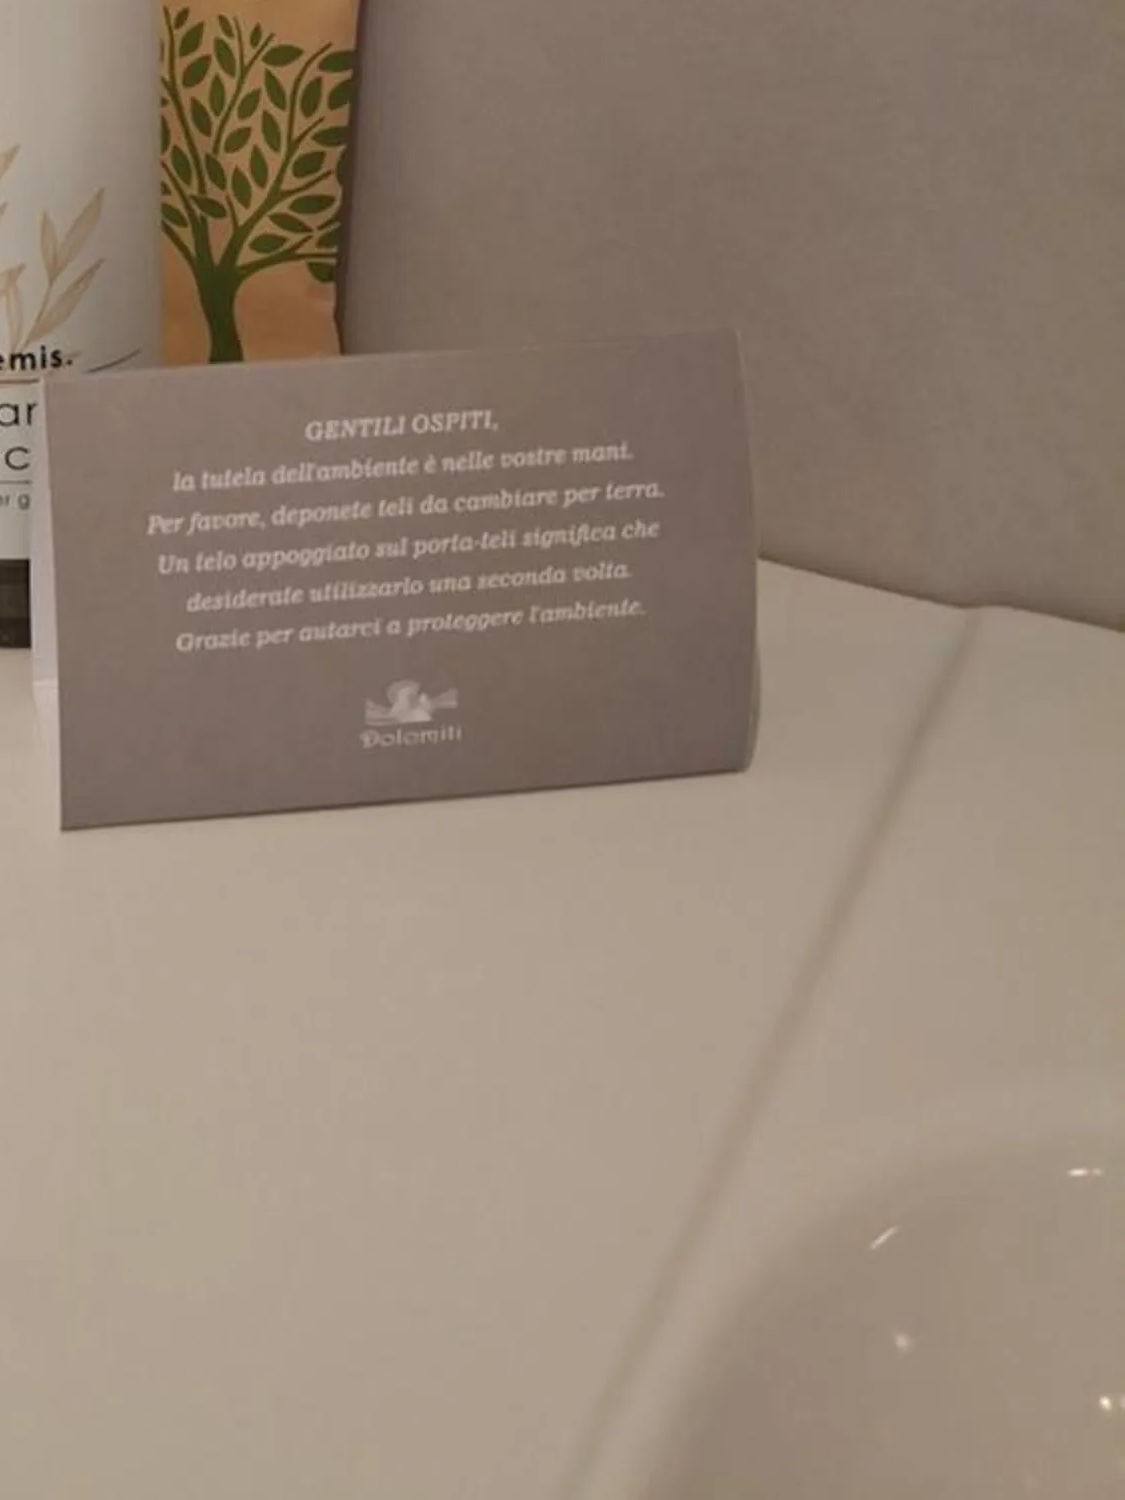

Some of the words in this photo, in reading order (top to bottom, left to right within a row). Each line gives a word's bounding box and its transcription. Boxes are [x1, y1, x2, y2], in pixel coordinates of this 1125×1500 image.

[305, 414, 406, 442] GENTILI
[412, 409, 499, 434] OSPITI,
[173, 470, 196, 492] la
[201, 466, 266, 490] tutela
[271, 455, 420, 486] dell'ambiente
[424, 452, 437, 475] è
[442, 450, 494, 473] nelle
[500, 446, 567, 470] vostre
[572, 440, 634, 463] mani.
[147, 513, 185, 535] Per
[186, 509, 266, 536] favore,
[271, 500, 373, 528] deponete
[377, 495, 414, 517] teli
[419, 493, 448, 515] da
[453, 488, 558, 513] cambiare
[562, 484, 601, 508] per
[606, 480, 665, 501] terra.
[158, 553, 190, 575] Un
[195, 550, 237, 572] telo
[241, 540, 371, 572] appoggiato
[375, 536, 408, 559] sul
[412, 529, 516, 560] porta-teli
[522, 523, 616, 549] significa
[620, 518, 660, 541] che
[186, 585, 305, 613] desiderate
[308, 576, 425, 603] utilizzarlo
[428, 575, 472, 594] una
[476, 564, 567, 591] seconda
[175, 628, 252, 653] Grazie
[254, 626, 296, 650] per
[386, 618, 402, 635] a
[406, 608, 525, 638] proteggere
[529, 597, 647, 625] l'ambiente.
[359, 723, 463, 749] Dolomiti
